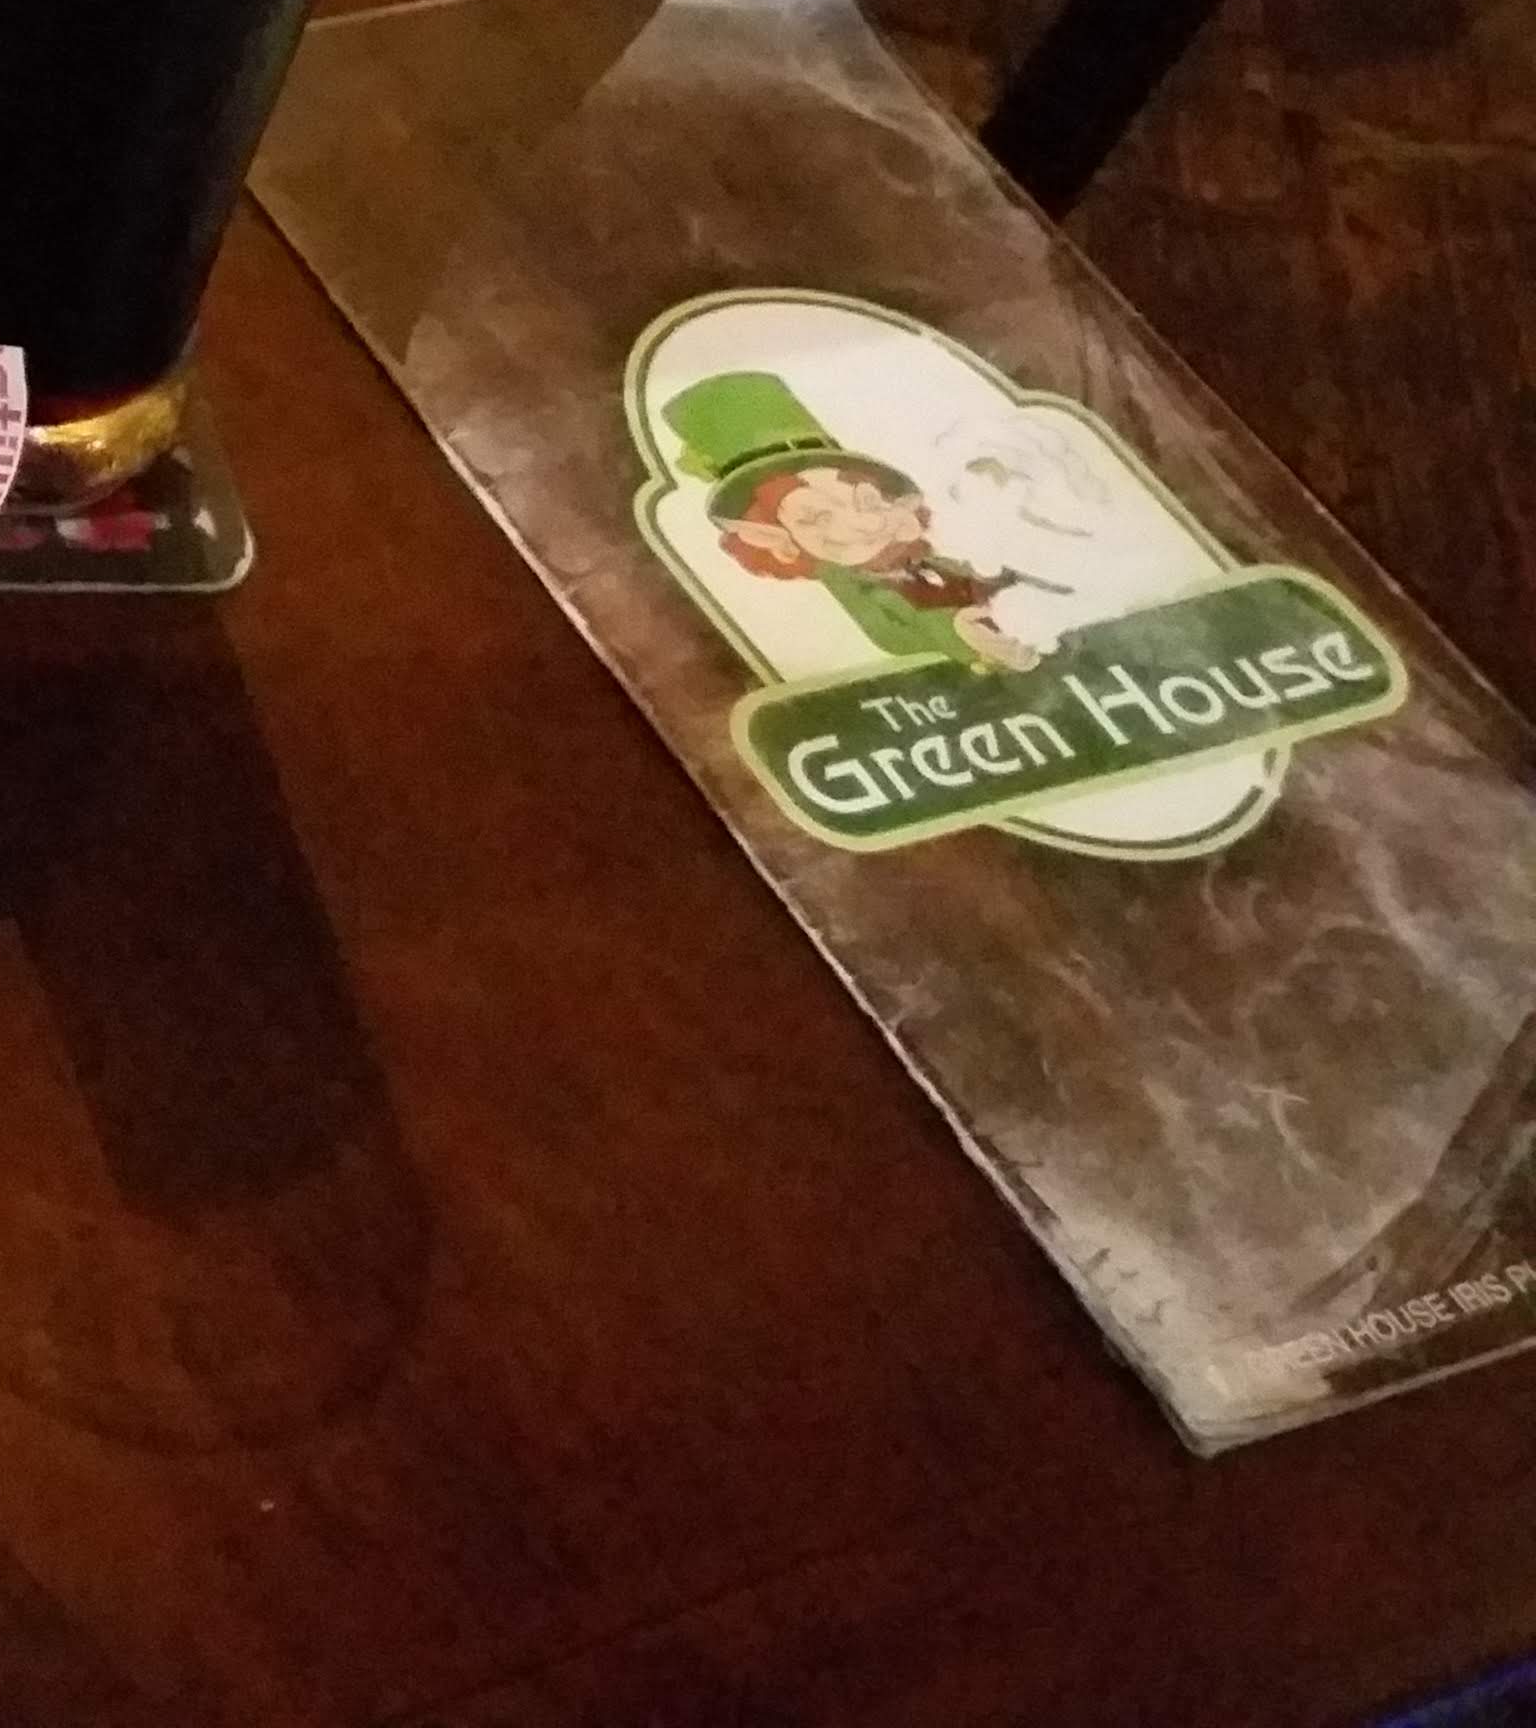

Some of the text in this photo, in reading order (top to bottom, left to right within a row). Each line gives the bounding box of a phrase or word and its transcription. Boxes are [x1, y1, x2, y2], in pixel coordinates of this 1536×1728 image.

[787, 629, 1374, 816] Green House
[861, 691, 957, 735] The
[1350, 1289, 1456, 1349] HOUSE
